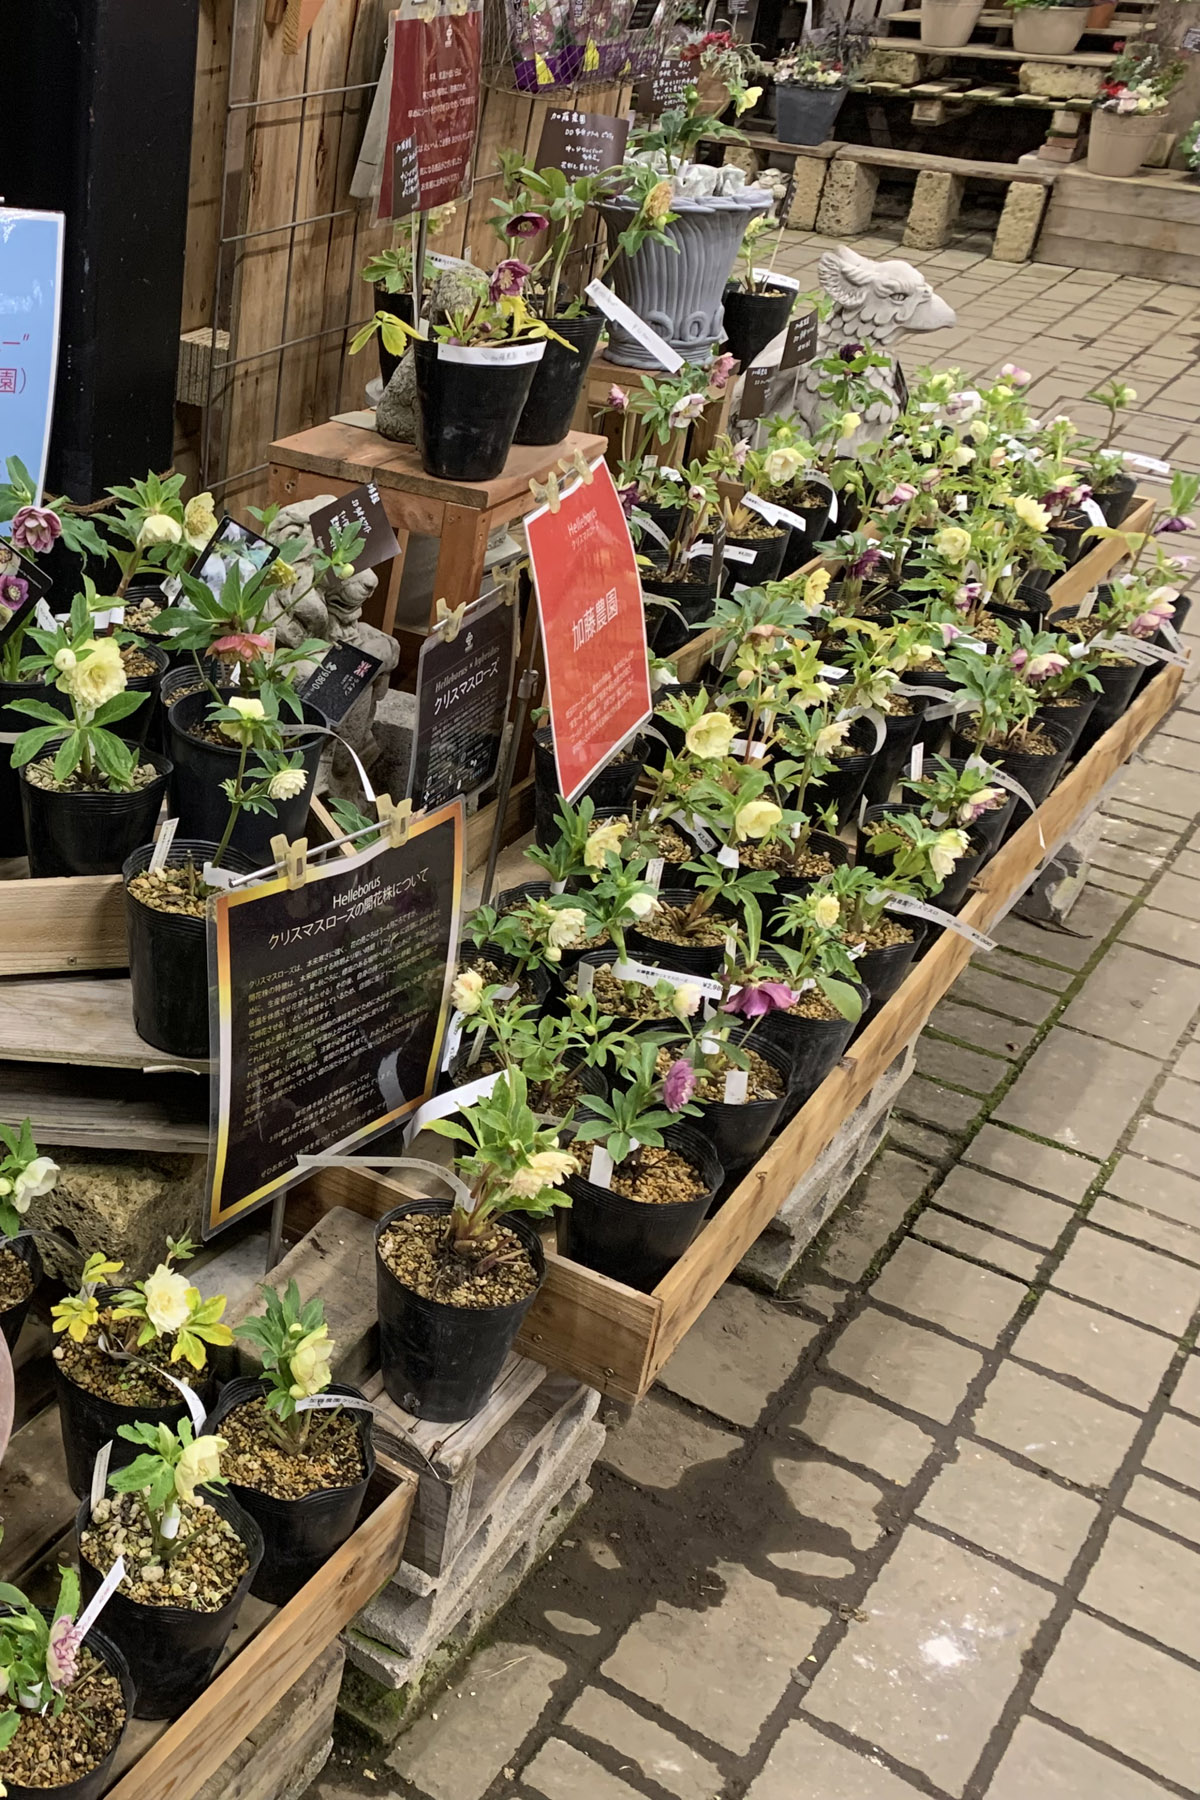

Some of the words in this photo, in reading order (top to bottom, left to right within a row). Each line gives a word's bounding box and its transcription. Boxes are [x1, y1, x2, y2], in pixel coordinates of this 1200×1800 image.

[567, 506, 598, 536] Helleborus
[572, 587, 619, 653] 加藤農園
[433, 657, 500, 716] クリスマスローズ
[268, 867, 430, 951] クリスマスローズの開花株について
[332, 875, 382, 909] Helleborus
